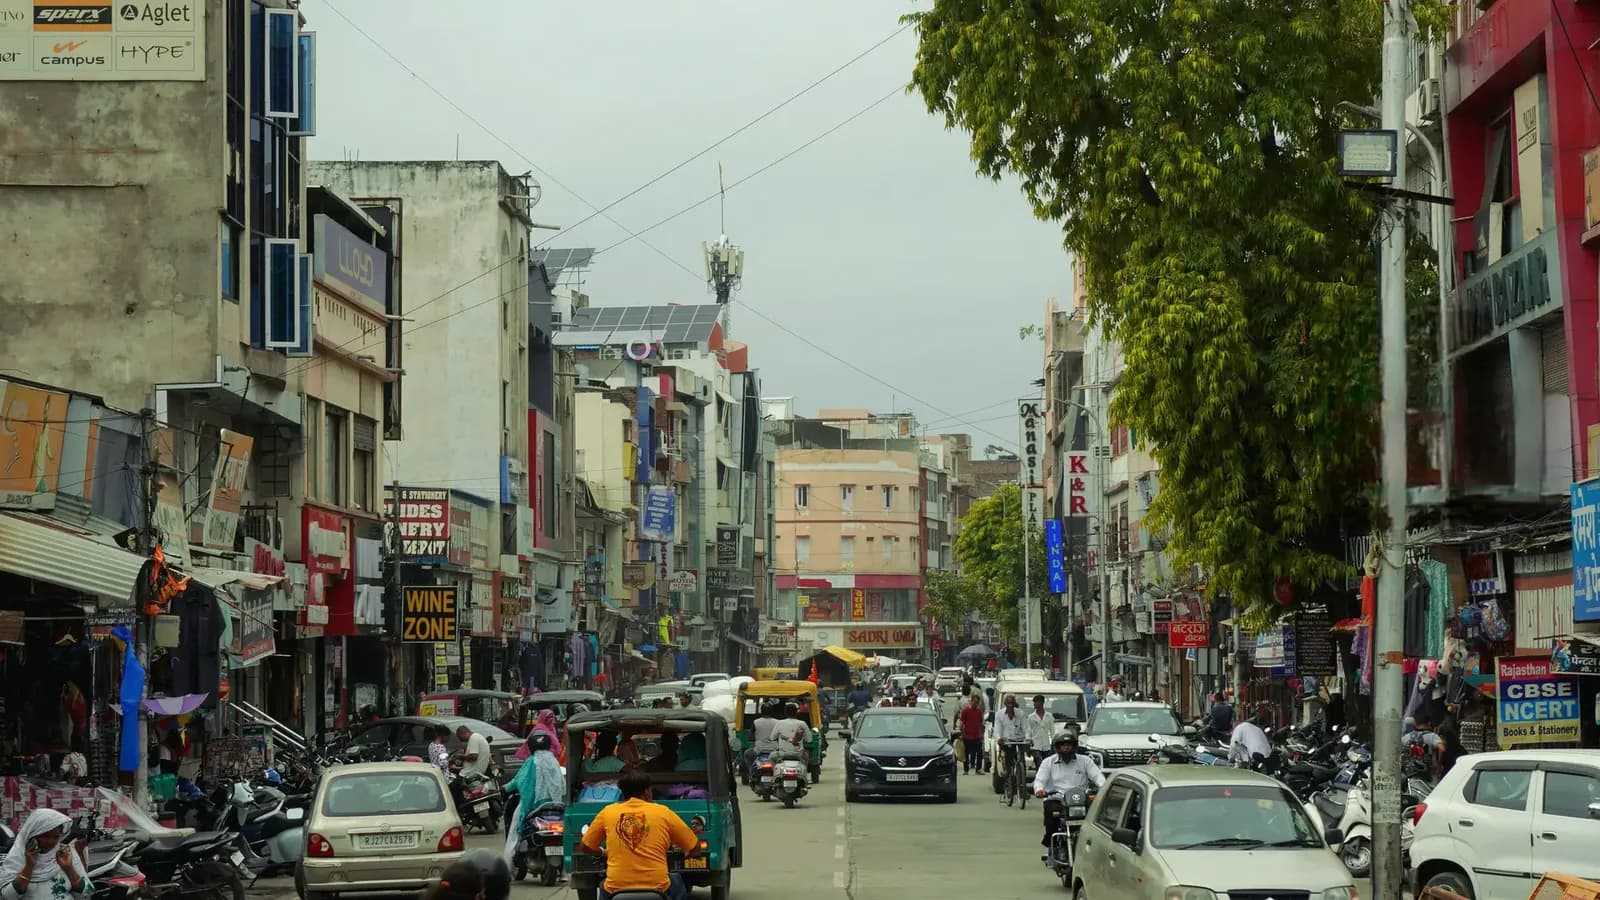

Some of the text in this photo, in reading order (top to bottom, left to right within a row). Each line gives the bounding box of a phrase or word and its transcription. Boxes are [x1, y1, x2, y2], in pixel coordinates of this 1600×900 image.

[37, 7, 108, 22] sparx
[141, 3, 190, 26] Aglet
[40, 55, 105, 67] campus
[121, 45, 184, 64] HYPE
[1051, 520, 1061, 593] JINDAL
[406, 590, 455, 612] WINE
[404, 617, 456, 640] ZONE
[1501, 664, 1547, 680] Rajasthan
[1507, 682, 1572, 699] CBSE
[1504, 701, 1576, 721] NCERT
[1503, 725, 1578, 737] Books & Stationery
